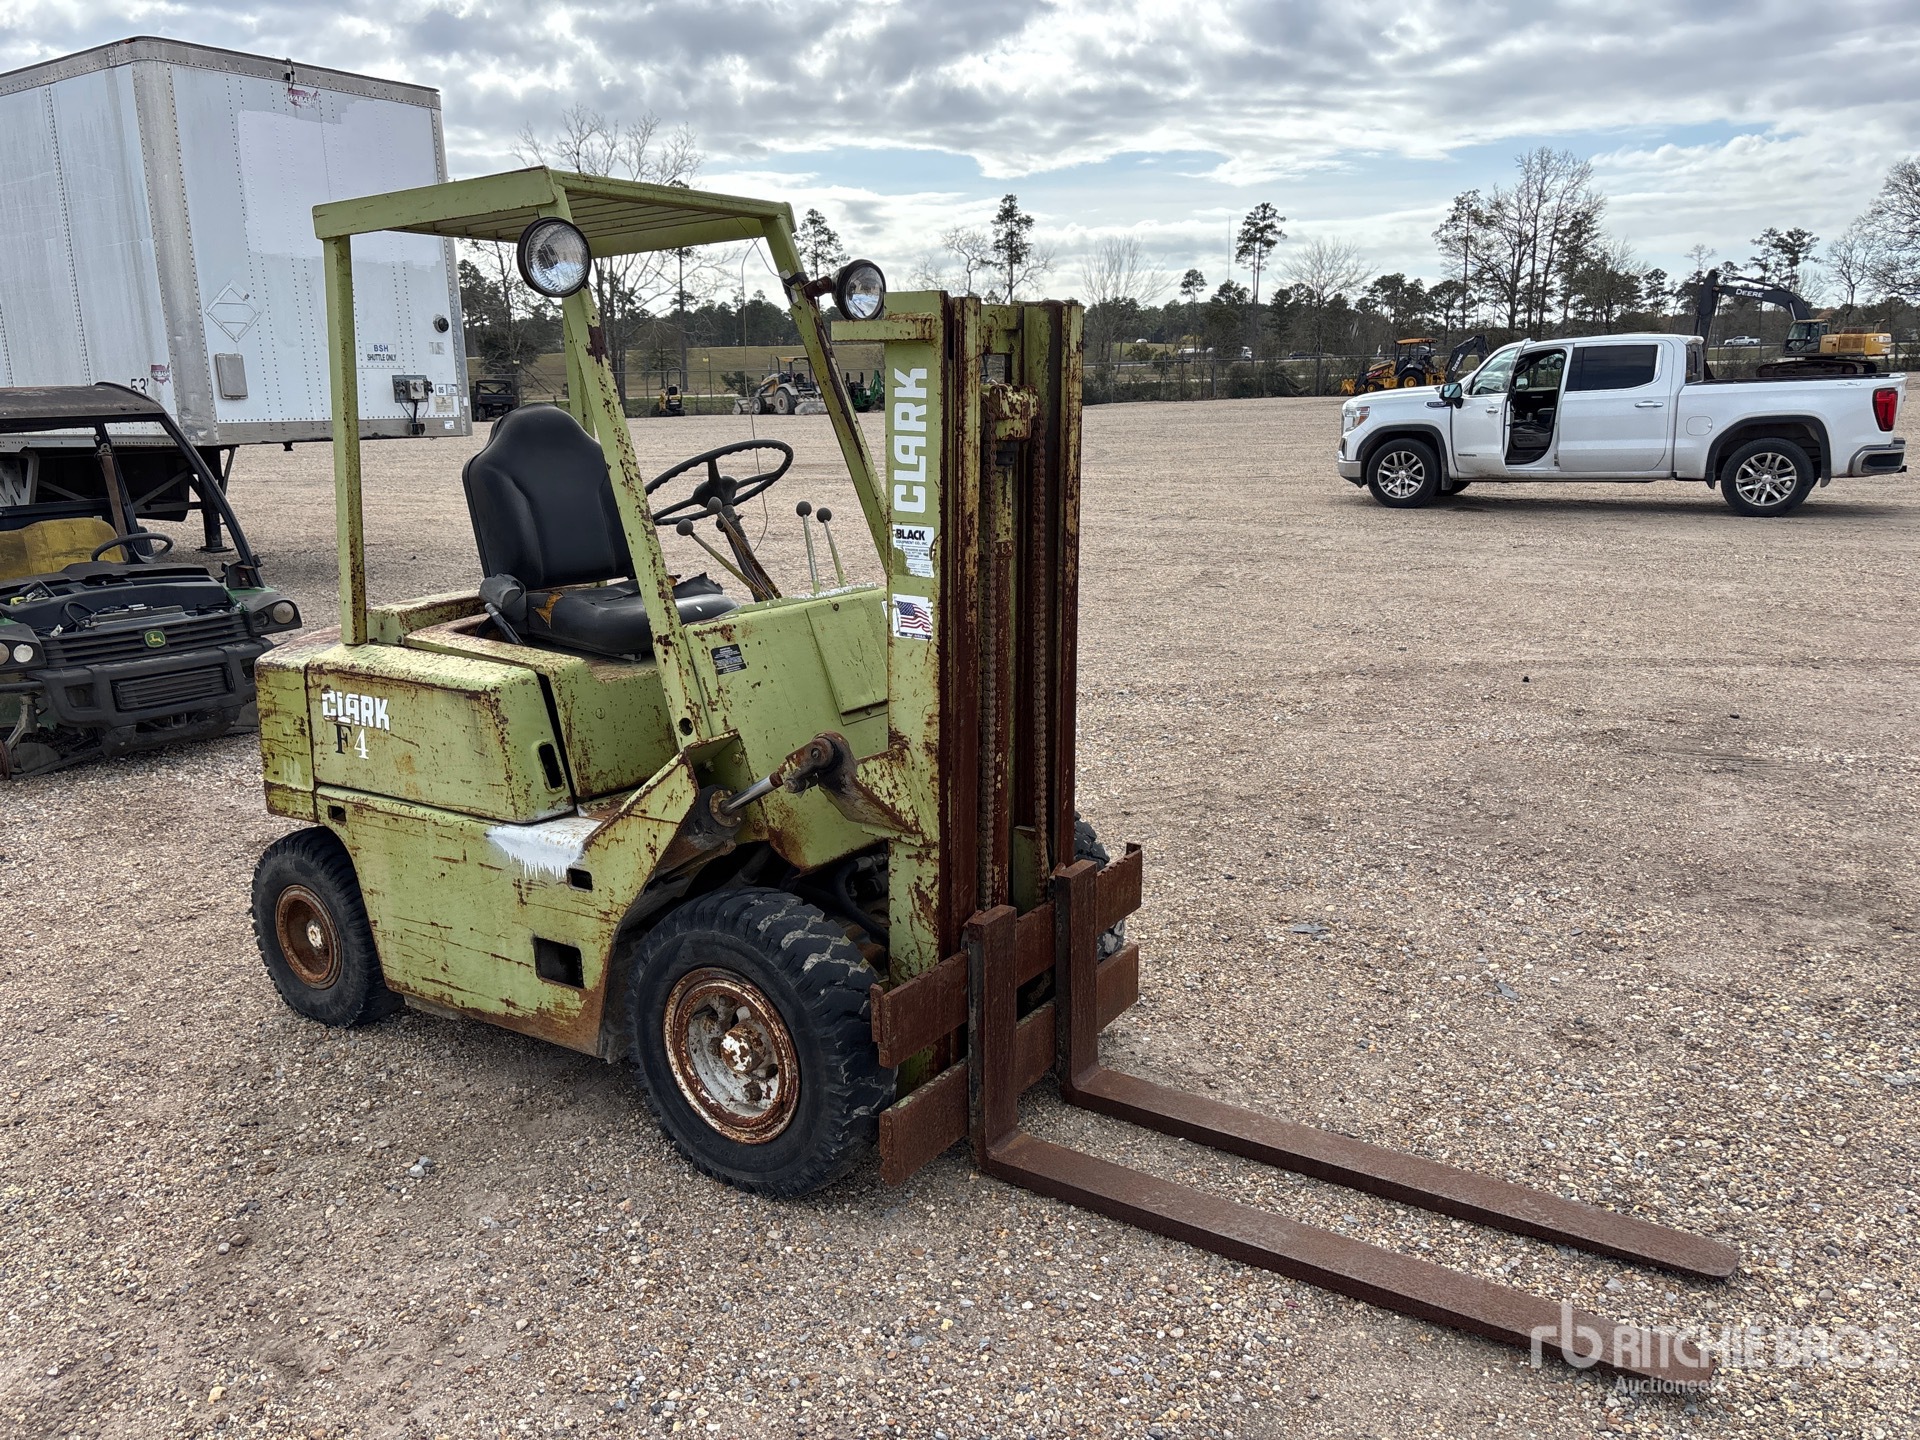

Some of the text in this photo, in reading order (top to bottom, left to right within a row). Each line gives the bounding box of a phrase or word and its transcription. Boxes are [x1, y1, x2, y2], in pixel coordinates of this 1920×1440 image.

[1735, 288, 1764, 298] DEERE
[373, 344, 389, 352] BSH
[366, 353, 397, 362] SHUTTLE ONLY
[893, 368, 928, 514] CLARK
[895, 529, 926, 541] BLACK
[321, 689, 391, 731] CLARK
